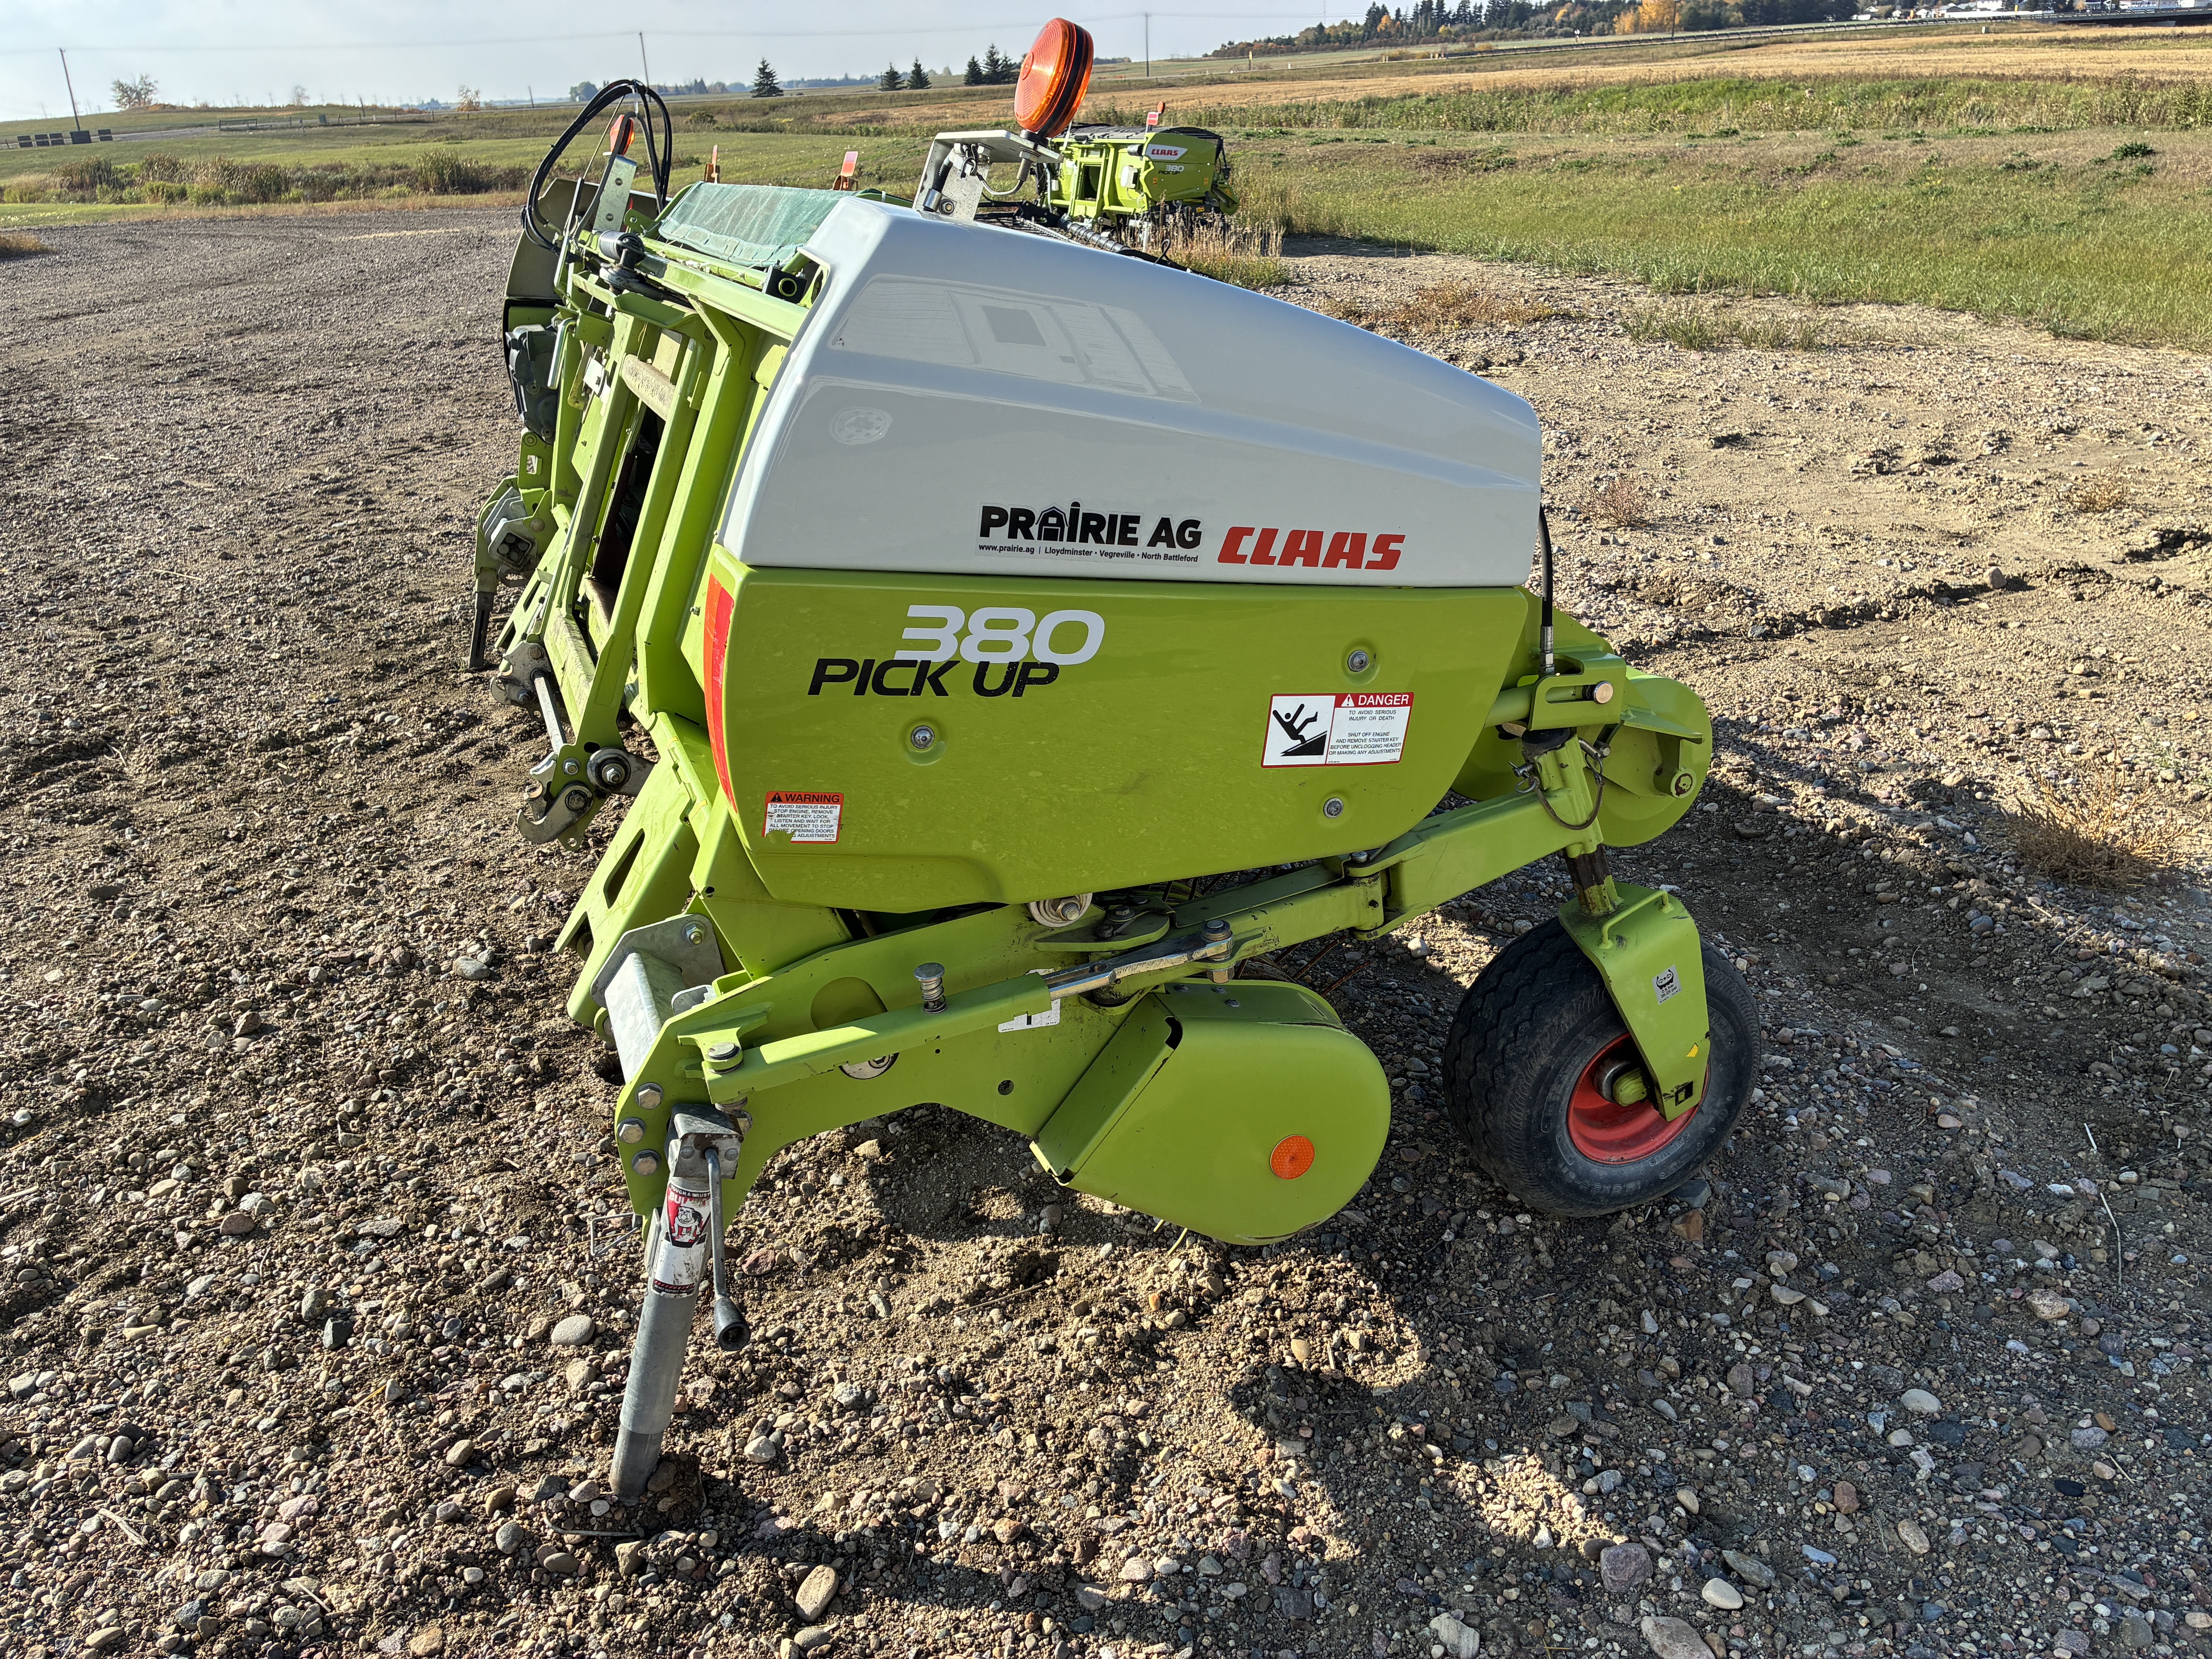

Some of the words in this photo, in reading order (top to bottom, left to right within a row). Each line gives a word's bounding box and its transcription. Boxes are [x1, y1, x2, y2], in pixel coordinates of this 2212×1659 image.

[980, 501, 1141, 546] PRAIRIE
[1147, 517, 1202, 549] AG
[979, 544, 1035, 554] www.prairie.ag
[1045, 547, 1093, 556] Lloydminster
[1100, 550, 1135, 558] Vegreville
[1163, 554, 1198, 562] Battleford
[1217, 526, 1406, 570] CLAAS
[894, 605, 1105, 665] 380
[807, 658, 960, 696] PICK
[972, 661, 1060, 697] UP
[1358, 694, 1409, 706] DANGER
[785, 794, 840, 803] WARNING
[671, 1184, 687, 1196] TOUGH
